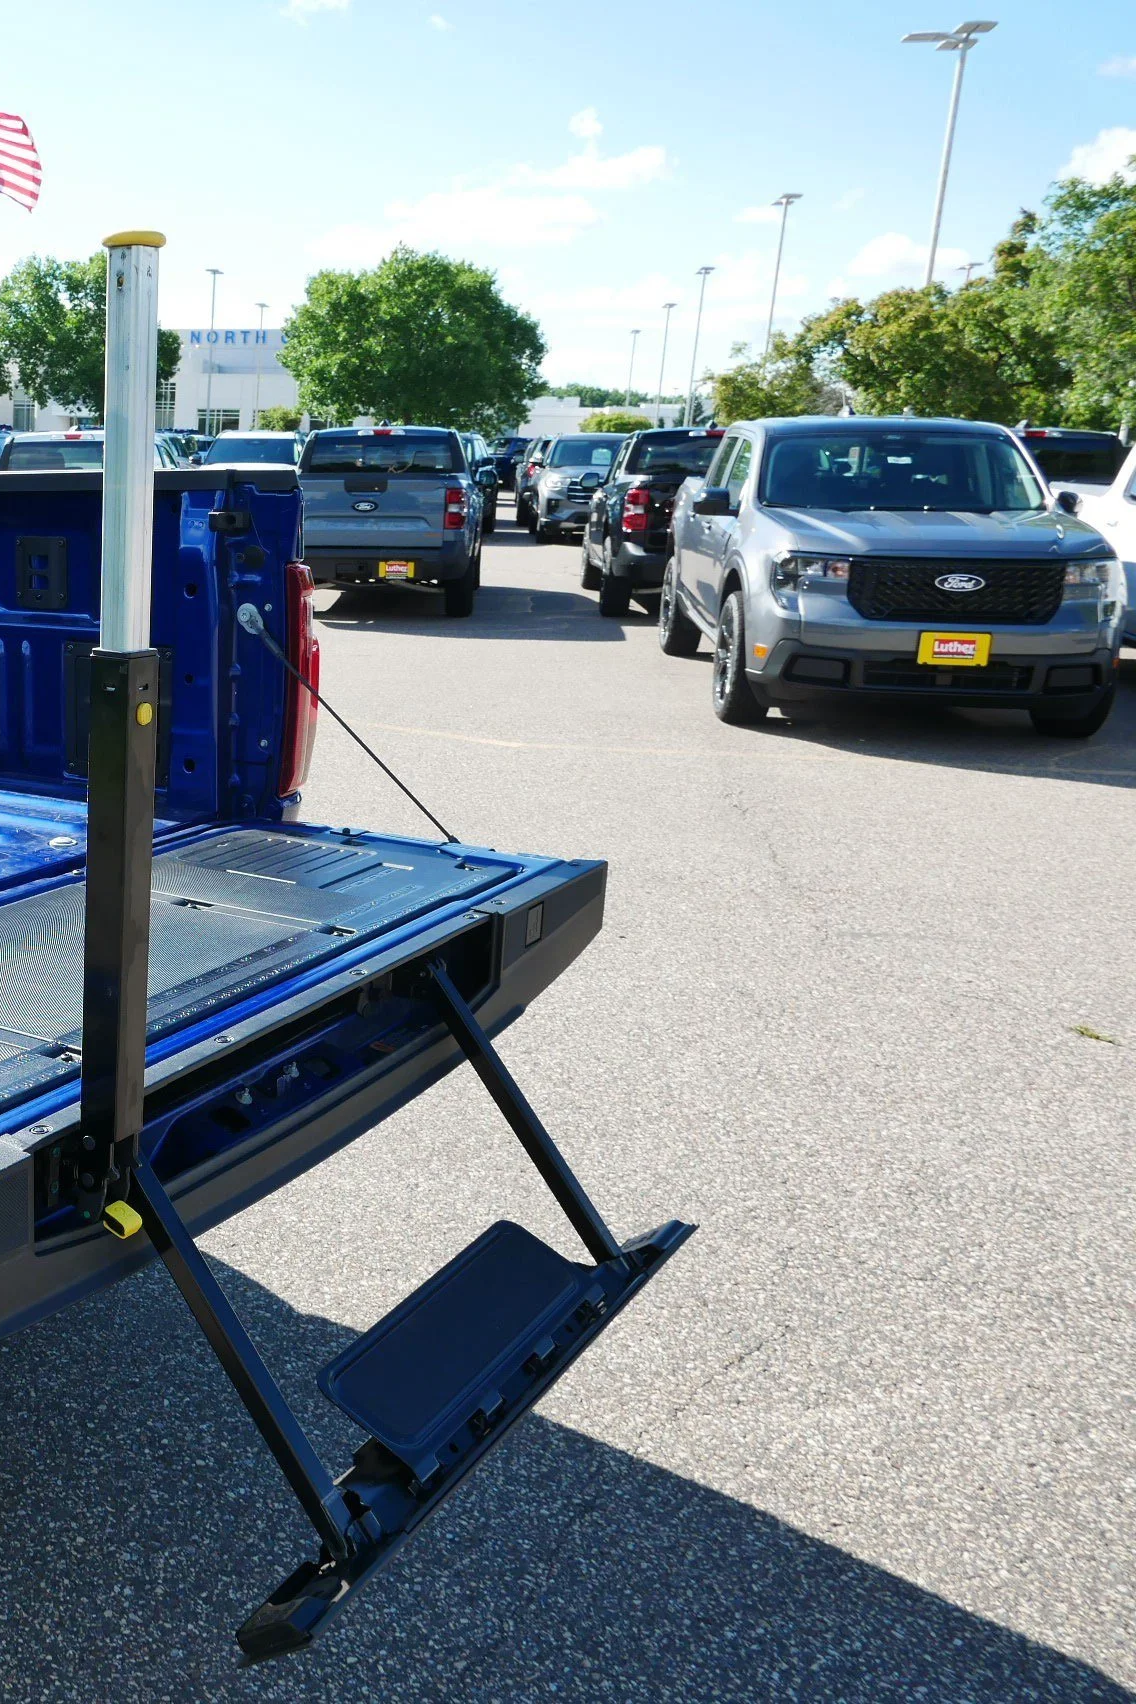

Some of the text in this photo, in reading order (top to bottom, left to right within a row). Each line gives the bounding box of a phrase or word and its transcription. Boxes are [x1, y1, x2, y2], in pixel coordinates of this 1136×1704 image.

[190, 330, 267, 344] NORTH
[943, 575, 977, 590] Ford
[933, 640, 976, 655] Luther
